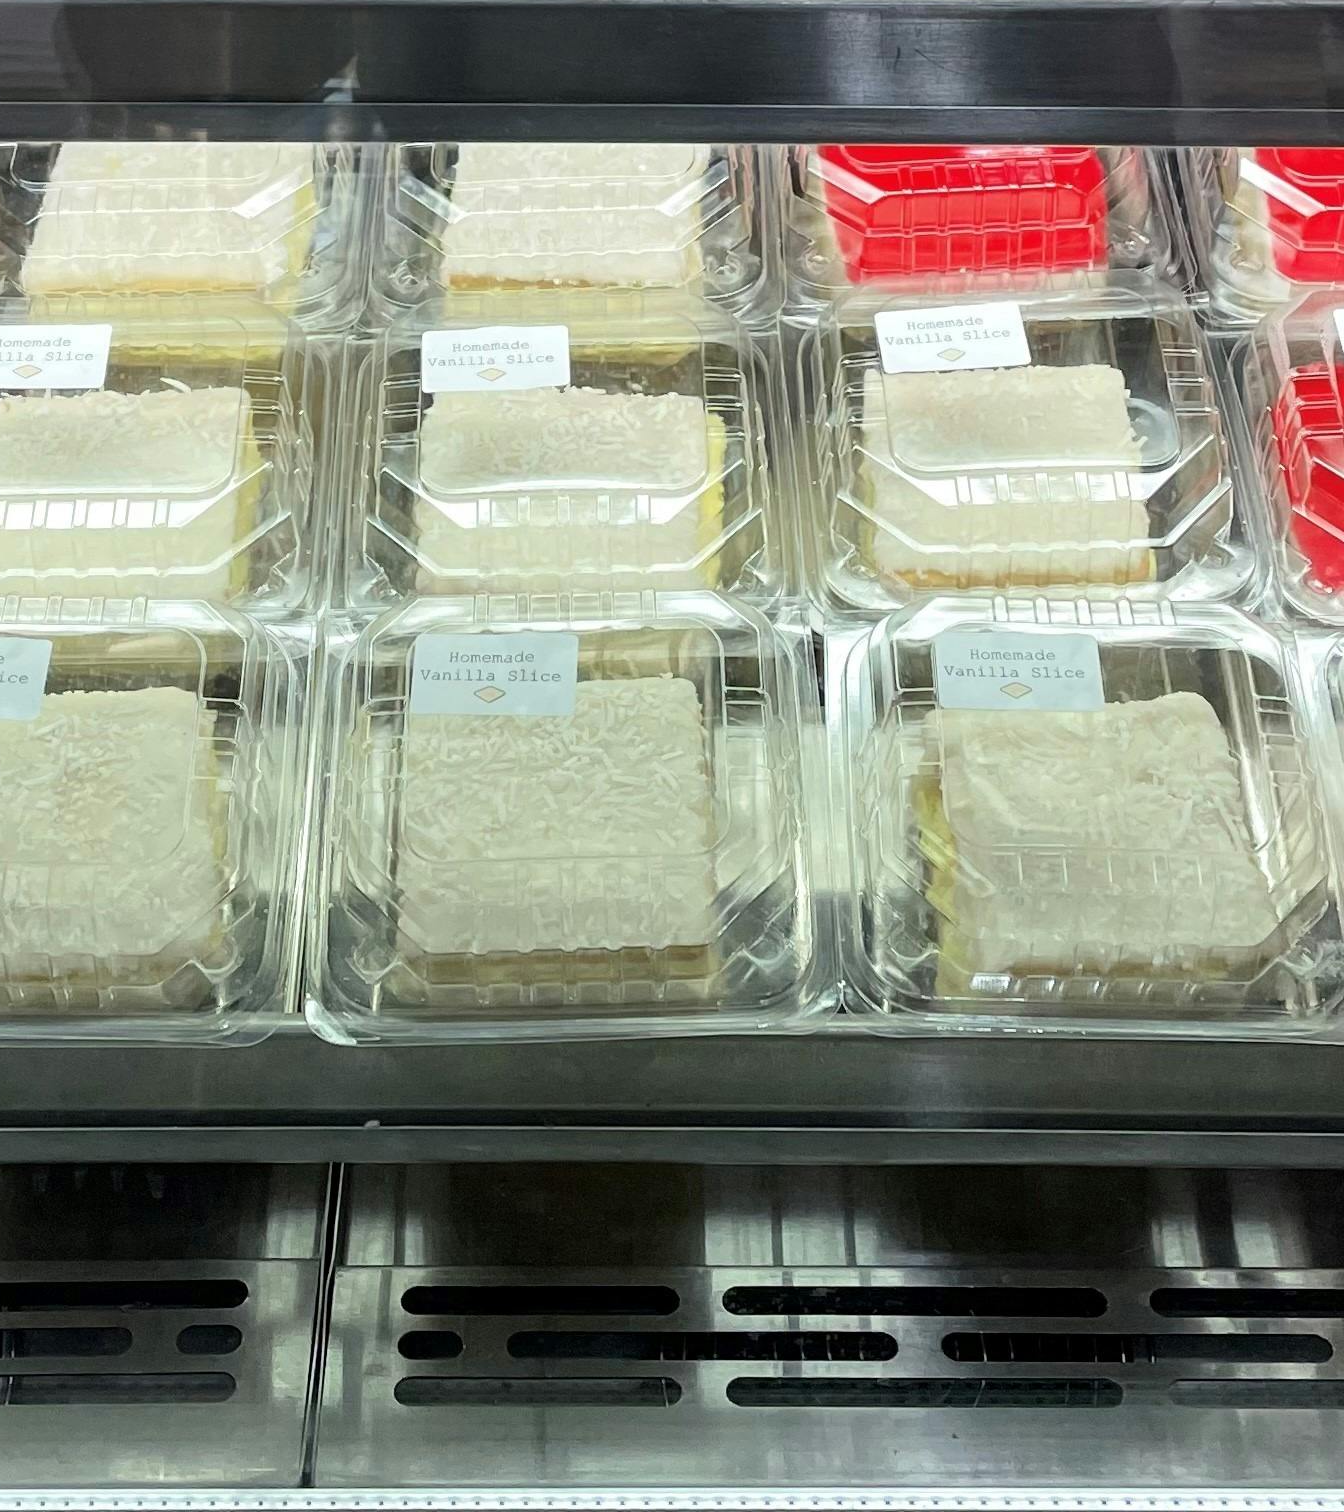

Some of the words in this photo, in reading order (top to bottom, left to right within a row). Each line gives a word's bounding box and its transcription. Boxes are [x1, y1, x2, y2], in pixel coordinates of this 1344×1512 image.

[906, 316, 984, 331] Homemade
[885, 333, 953, 346] Vanilla
[962, 327, 1011, 341] Slice
[452, 340, 530, 353] Homemade
[44, 351, 94, 361] Slice
[427, 356, 496, 367] Vanilla
[506, 353, 555, 365] Slice
[449, 650, 535, 663] Homemade
[970, 648, 1056, 661] Homemade
[420, 669, 496, 682] Vanilla
[507, 669, 562, 682] Slice
[943, 665, 1020, 678] Vanilla
[1031, 667, 1085, 679] Slice
